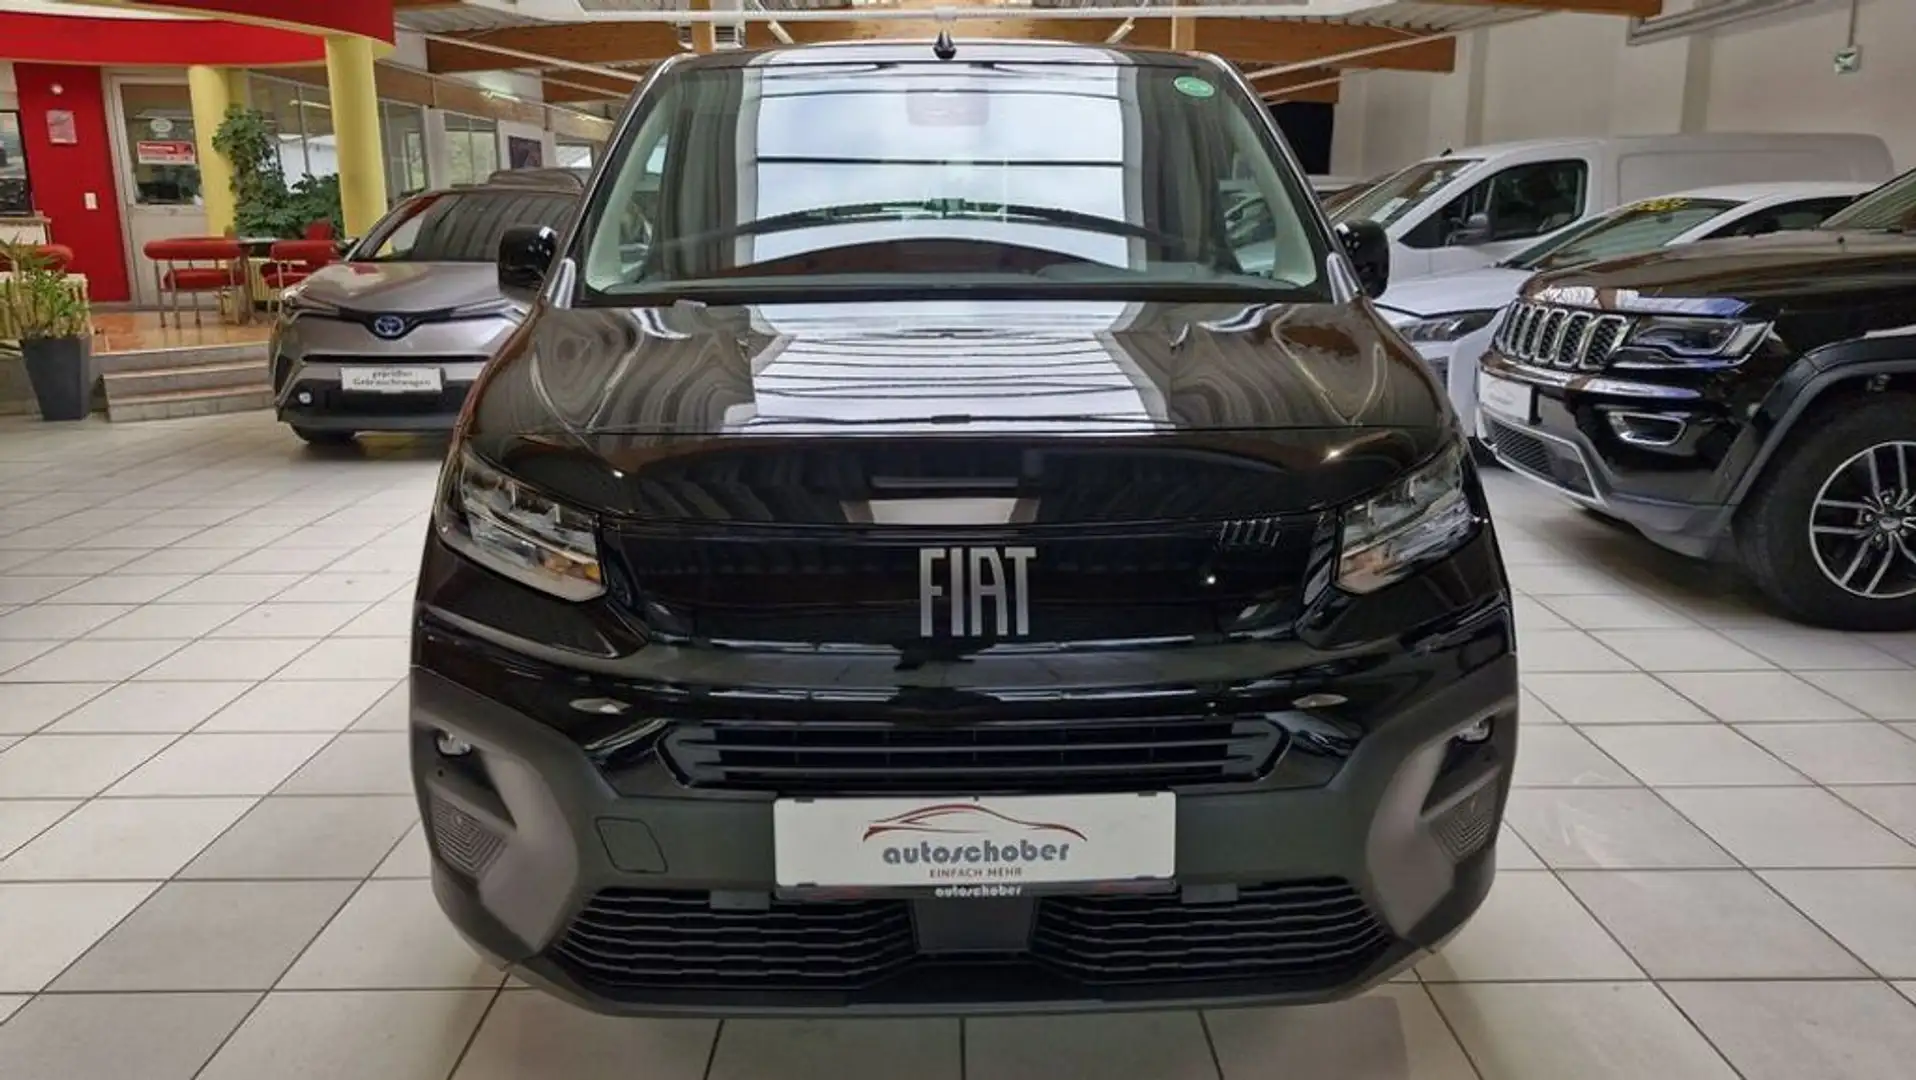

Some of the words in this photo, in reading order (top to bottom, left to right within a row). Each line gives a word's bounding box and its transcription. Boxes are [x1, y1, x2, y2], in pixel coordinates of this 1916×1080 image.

[919, 547, 1037, 637] FIAT
[882, 838, 1070, 865] autoschober
[929, 868, 983, 879] EINFACH
[987, 867, 1023, 878] MEHR
[934, 884, 1022, 898] autoschober
